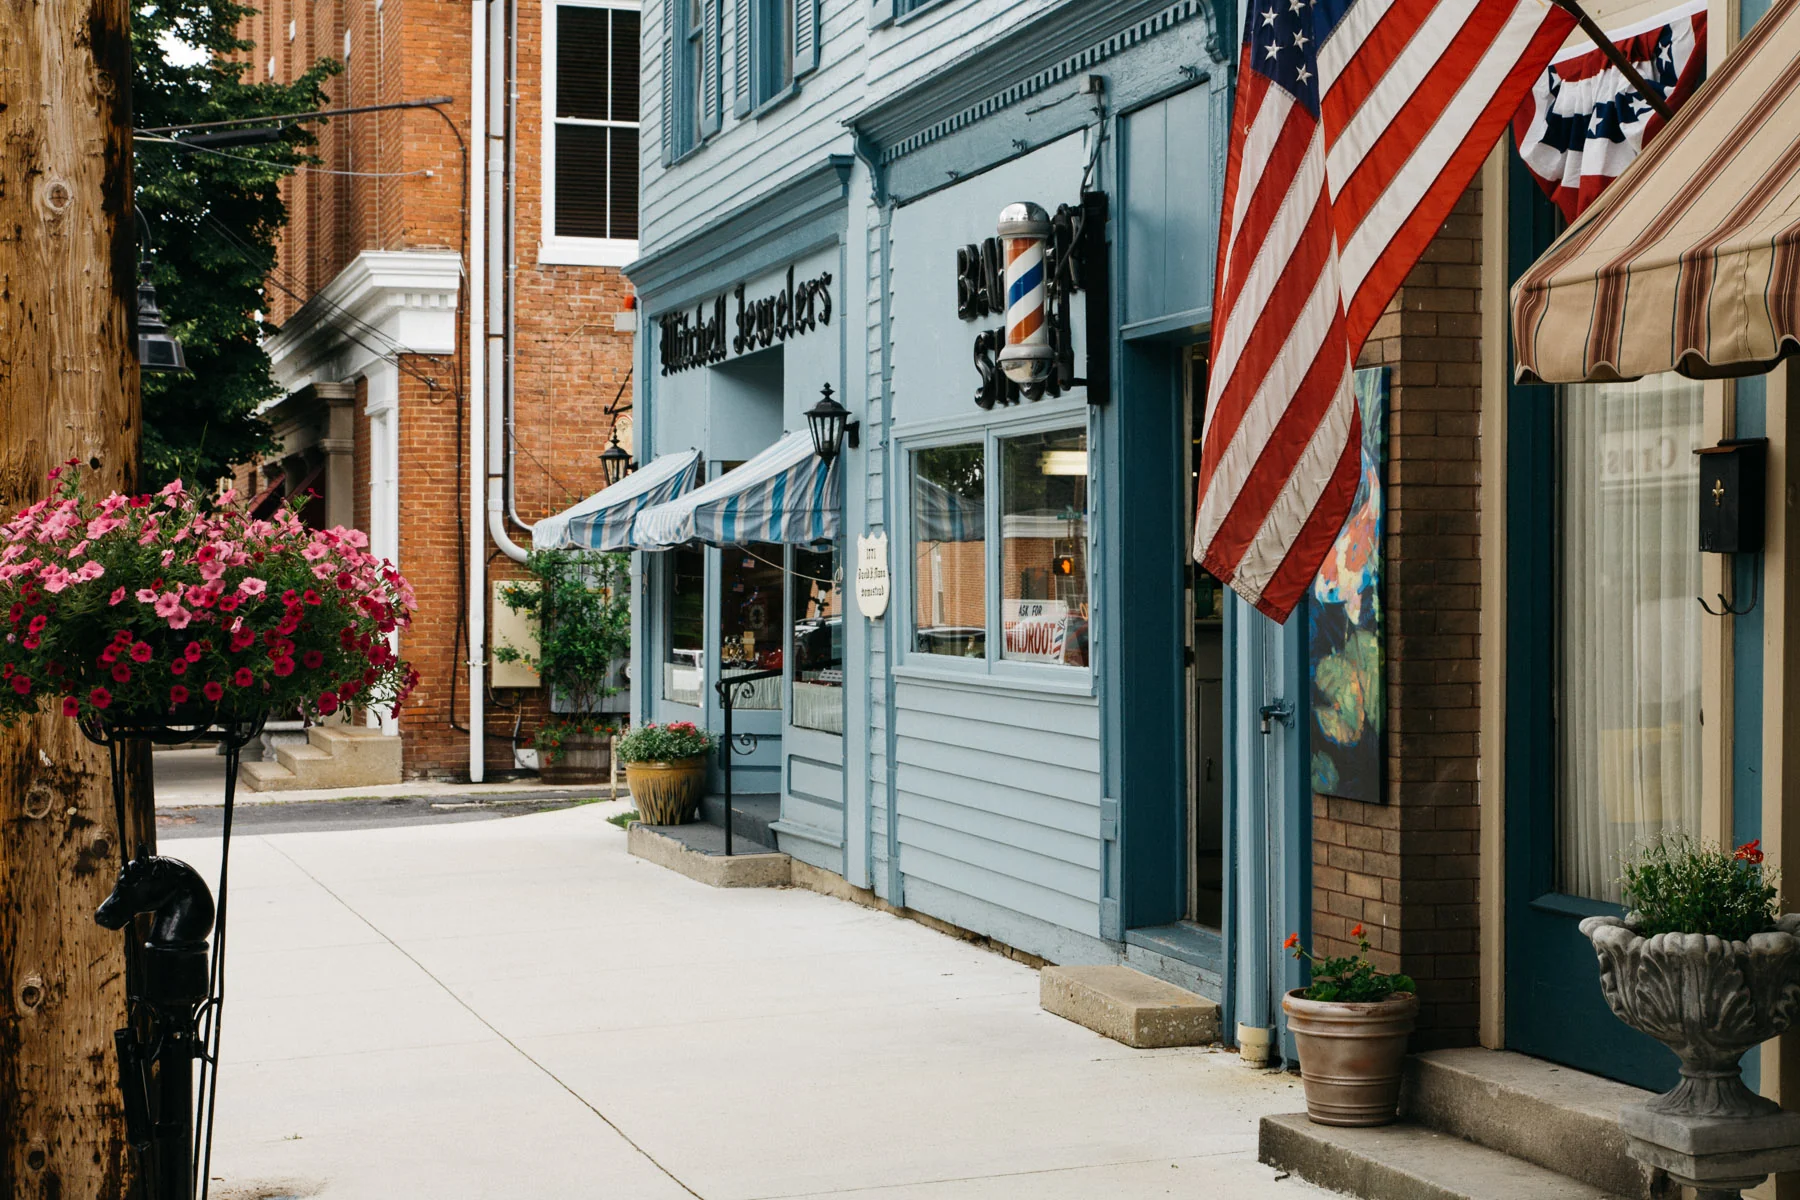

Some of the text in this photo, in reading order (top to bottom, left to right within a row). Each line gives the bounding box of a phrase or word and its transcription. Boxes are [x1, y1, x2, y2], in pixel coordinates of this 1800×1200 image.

[733, 265, 832, 354] Jewelers
[1018, 604, 1043, 616] ASK FOR
[1004, 620, 1056, 655] WILDROOT
